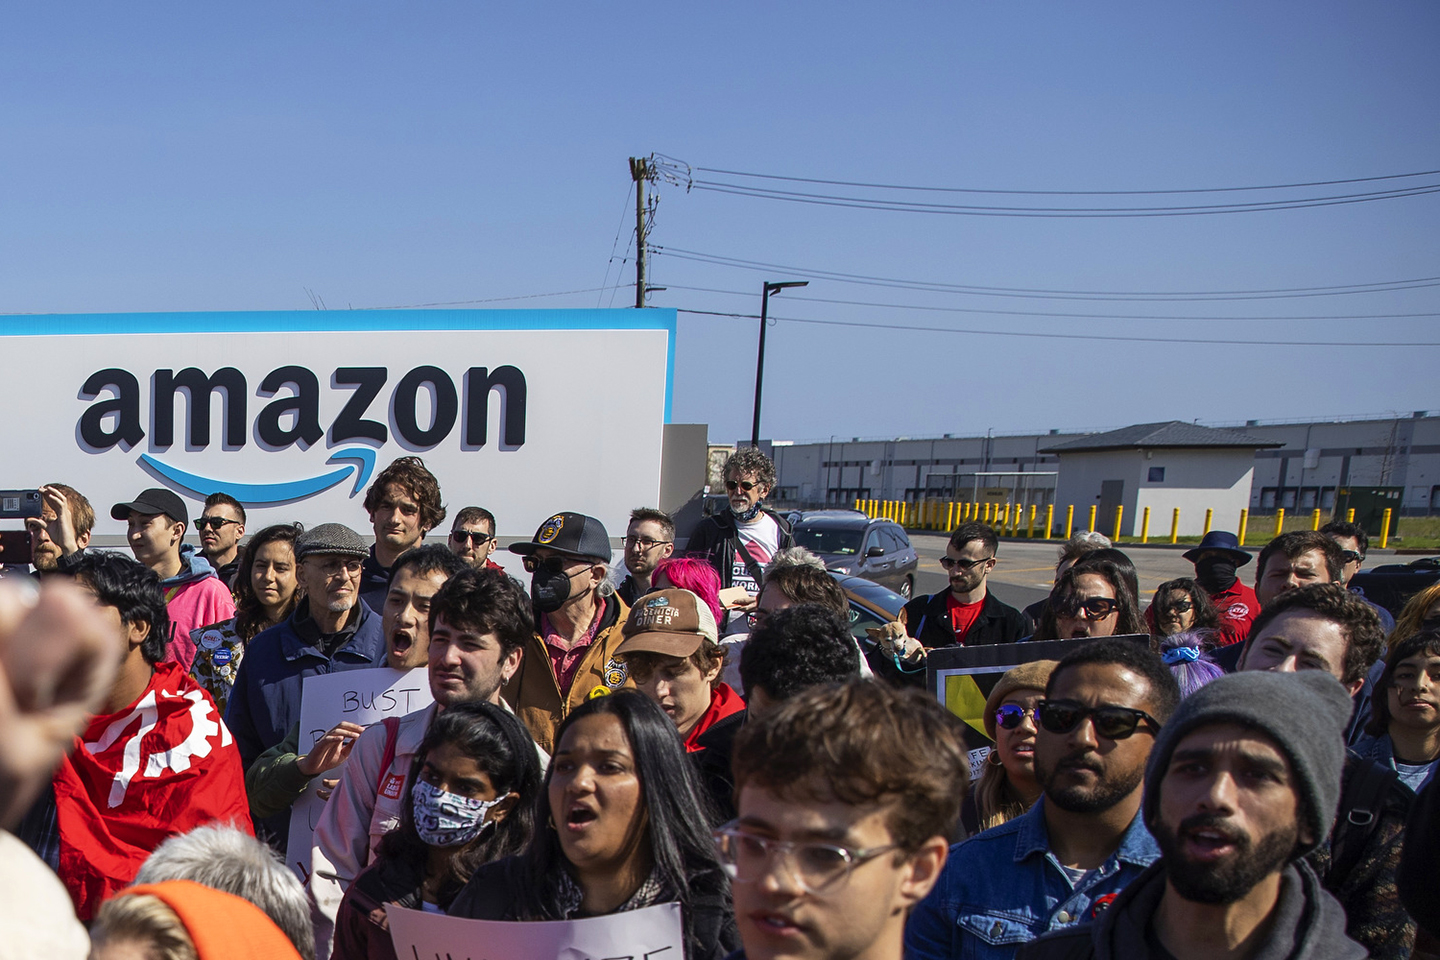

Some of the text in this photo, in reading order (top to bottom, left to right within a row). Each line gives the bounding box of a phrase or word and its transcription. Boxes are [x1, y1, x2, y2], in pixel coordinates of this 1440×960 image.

[75, 364, 527, 454] amazon
[636, 614, 672, 627] DINER
[342, 688, 421, 713] BUST
